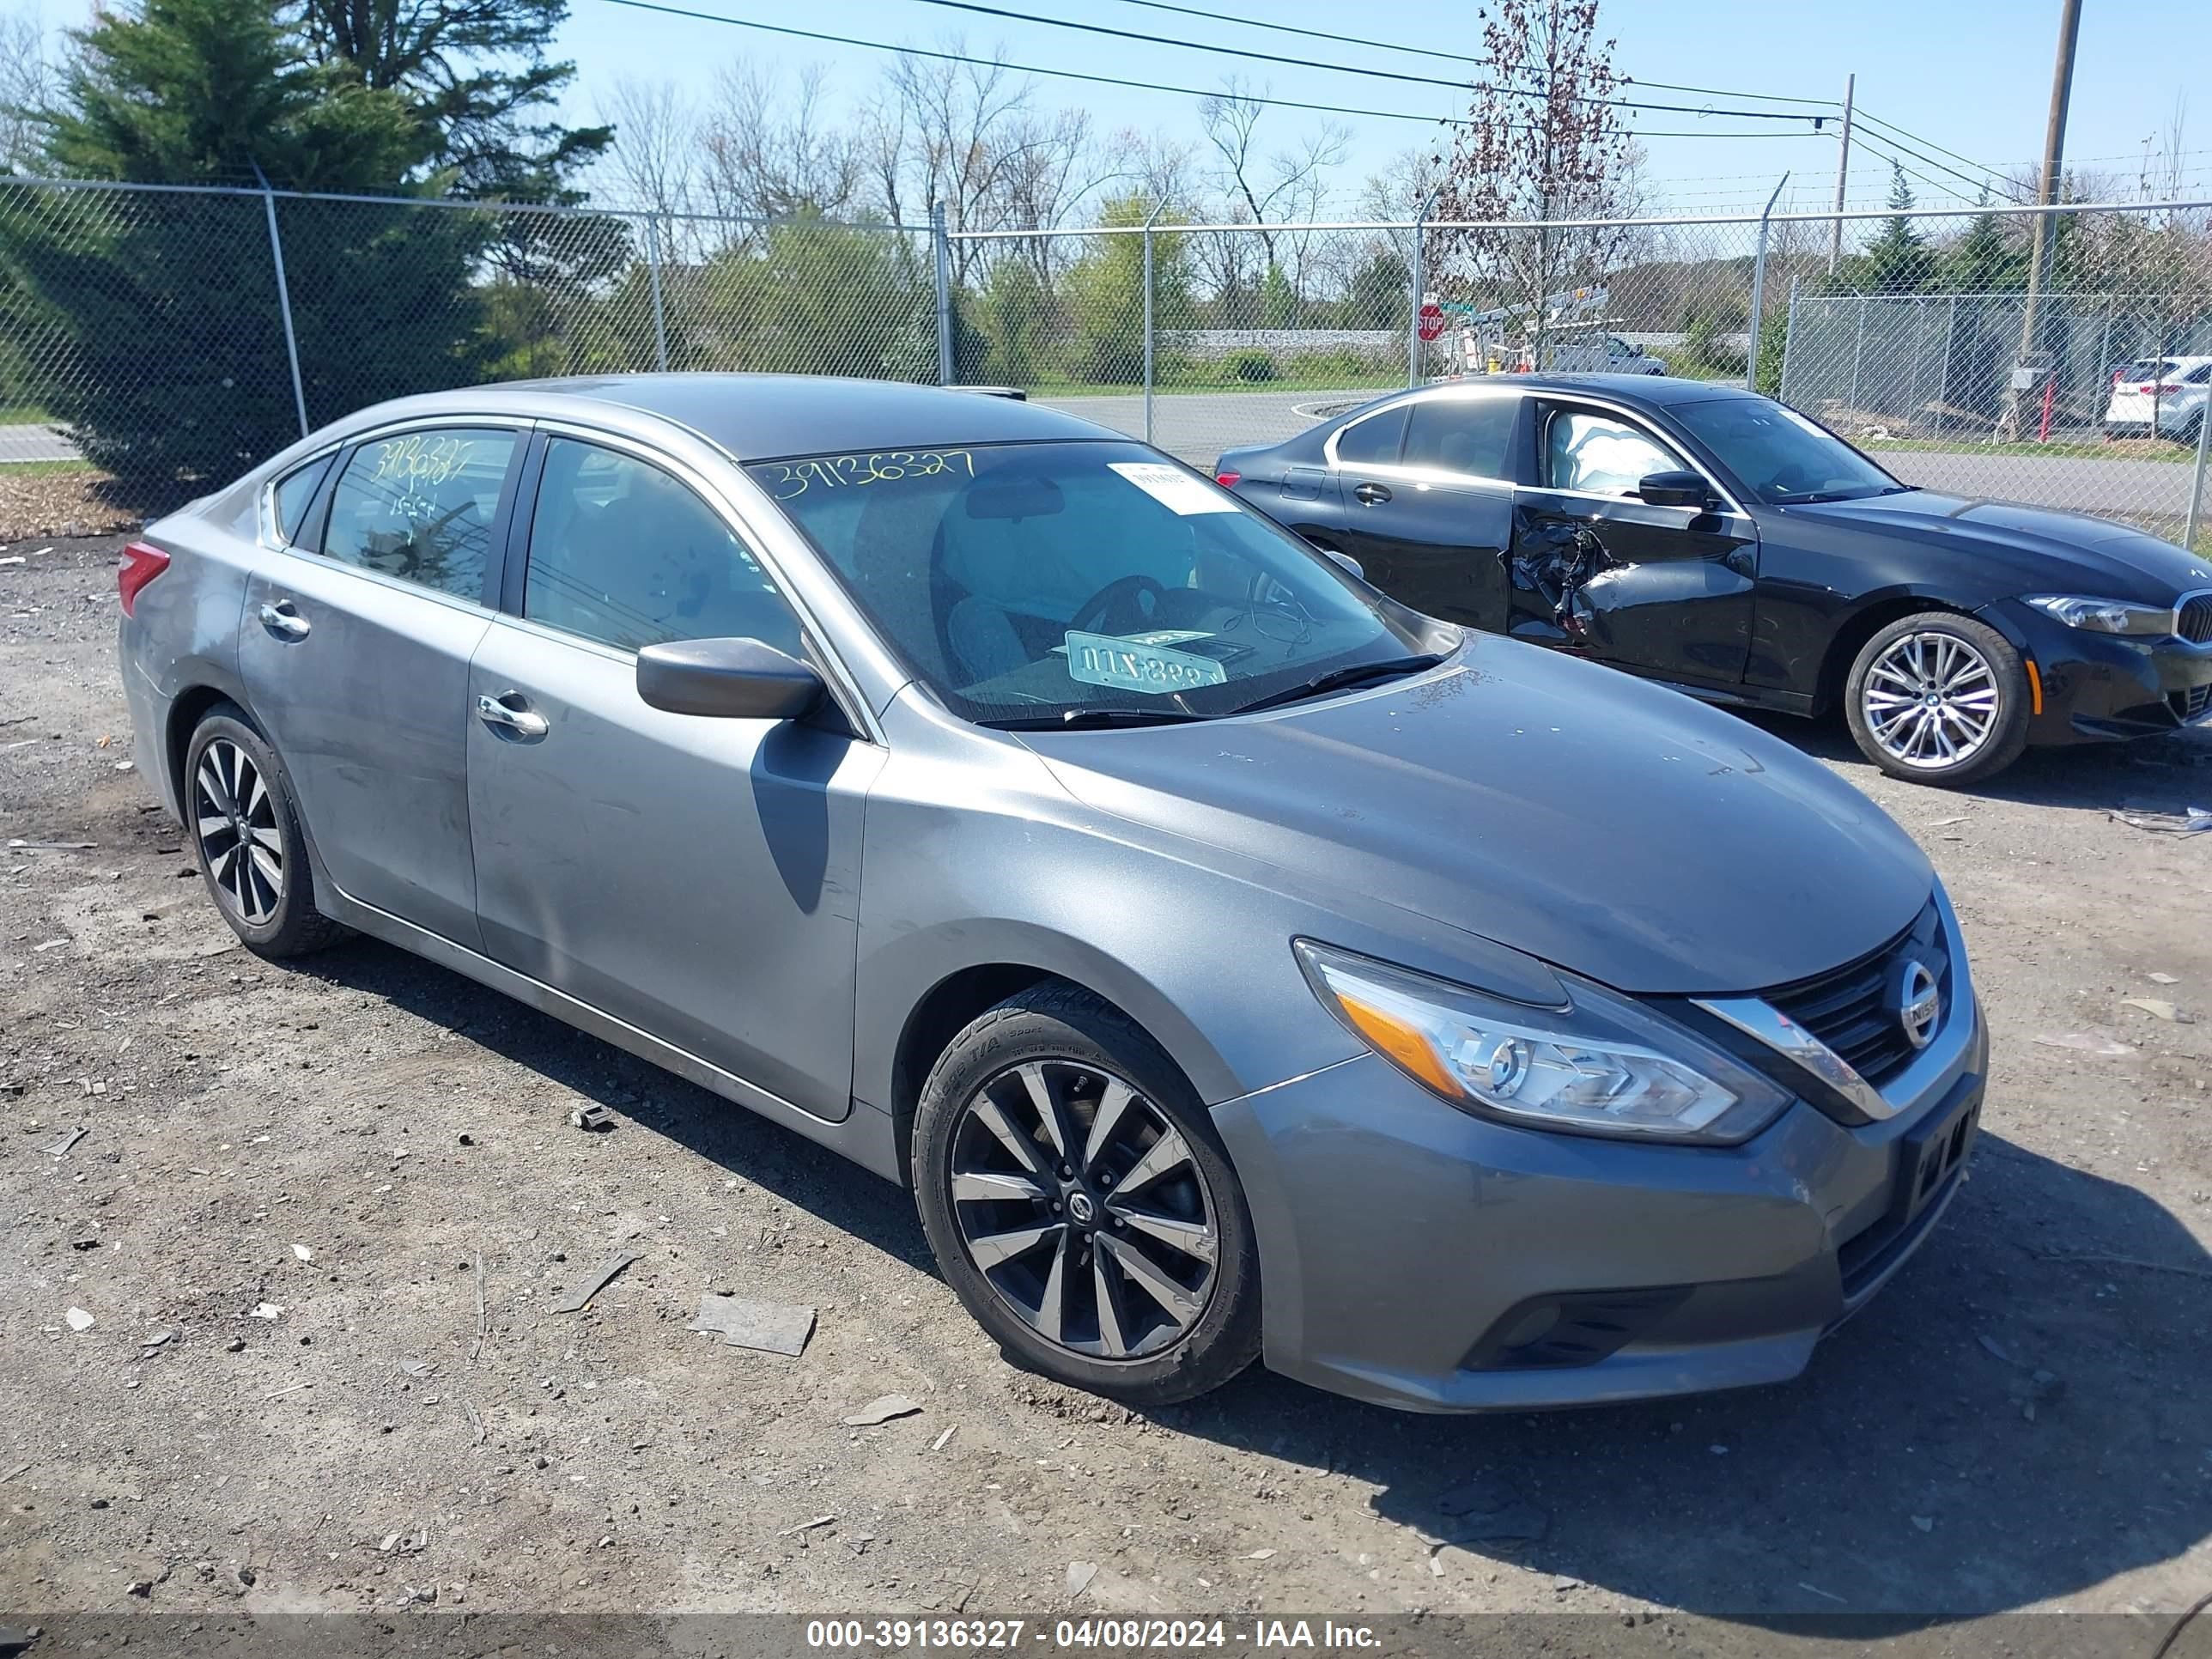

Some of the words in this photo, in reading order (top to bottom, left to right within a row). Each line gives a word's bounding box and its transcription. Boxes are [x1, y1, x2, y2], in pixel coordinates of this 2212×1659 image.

[1419, 315, 1443, 331] STOP
[773, 451, 975, 500] 39136327
[1911, 994, 1938, 1023] NISS
